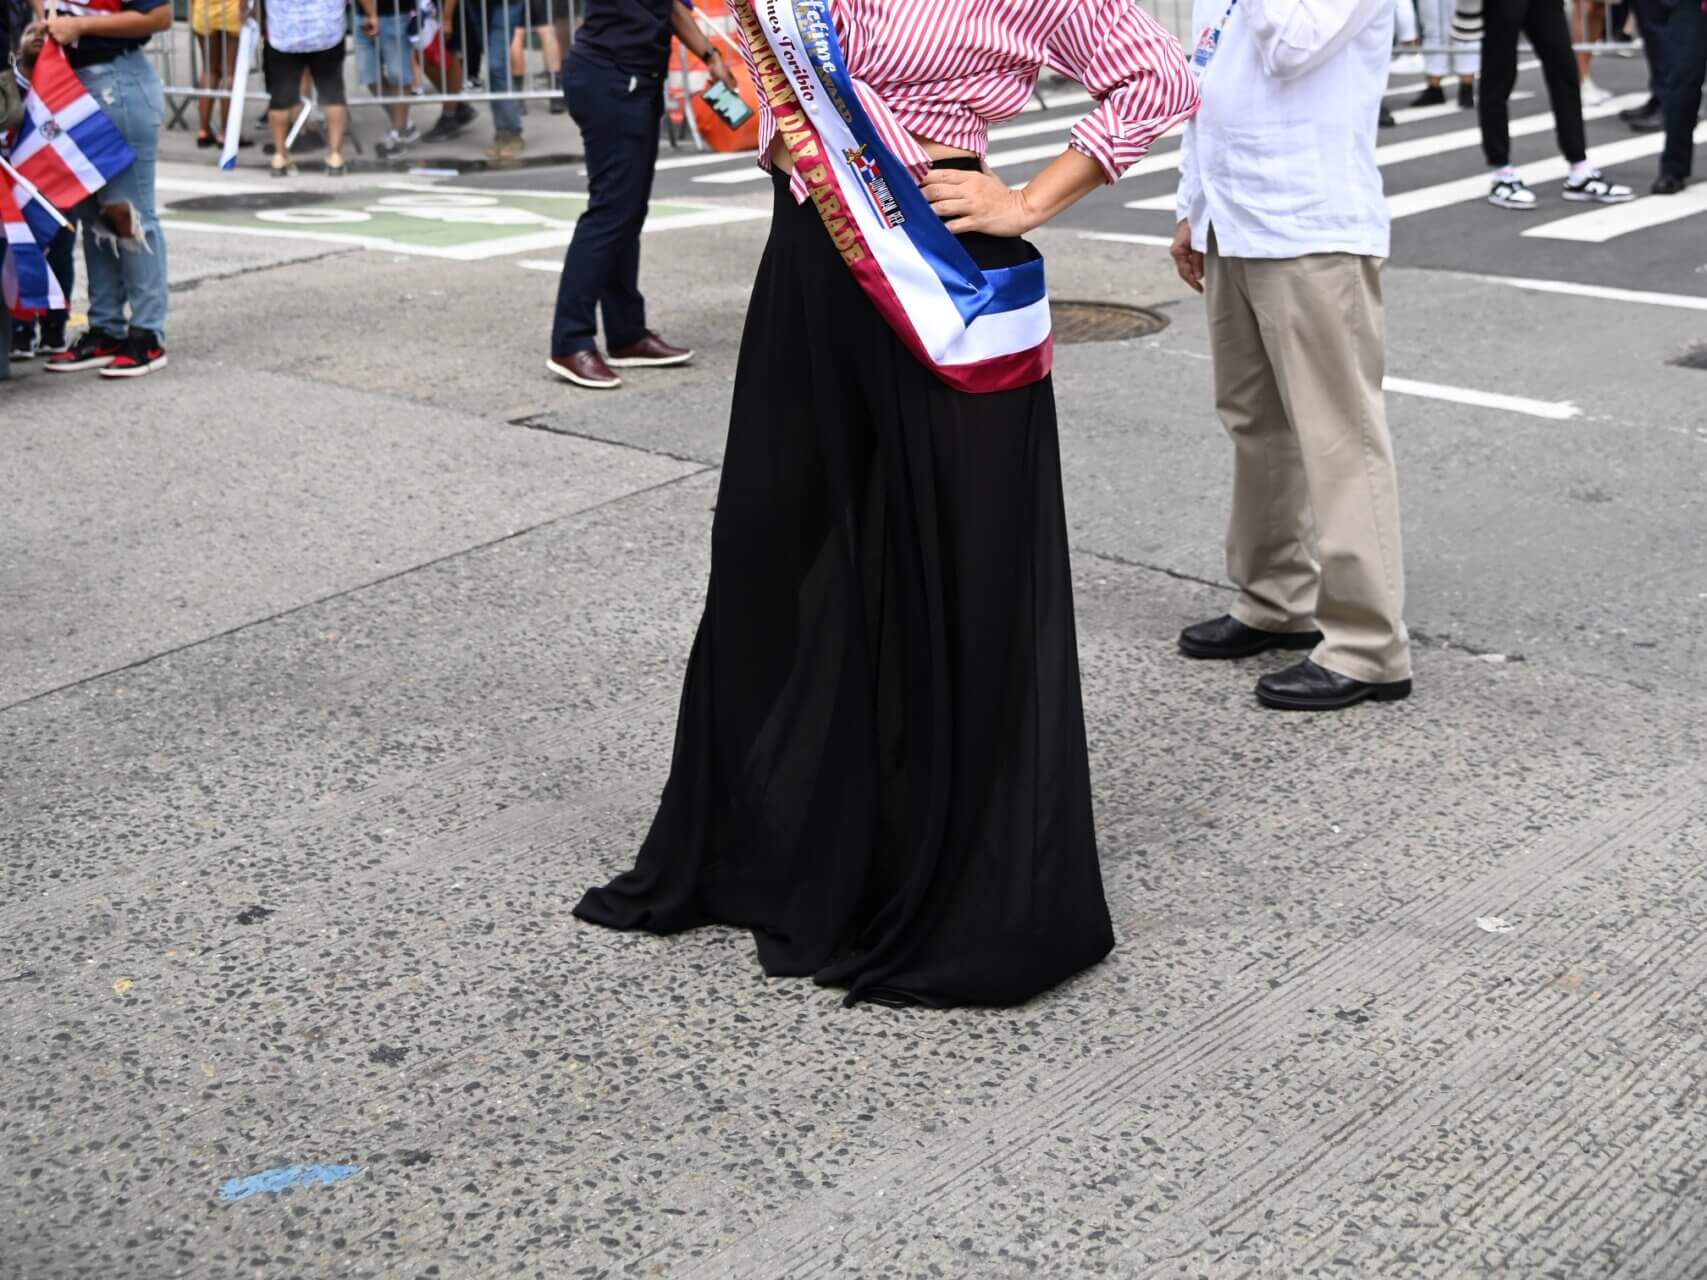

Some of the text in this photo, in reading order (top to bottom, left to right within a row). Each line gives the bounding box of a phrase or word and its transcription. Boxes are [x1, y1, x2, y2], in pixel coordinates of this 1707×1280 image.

[779, 36, 815, 102] Toribio
[776, 109, 820, 163] DAY
[801, 161, 866, 267] PARADE
